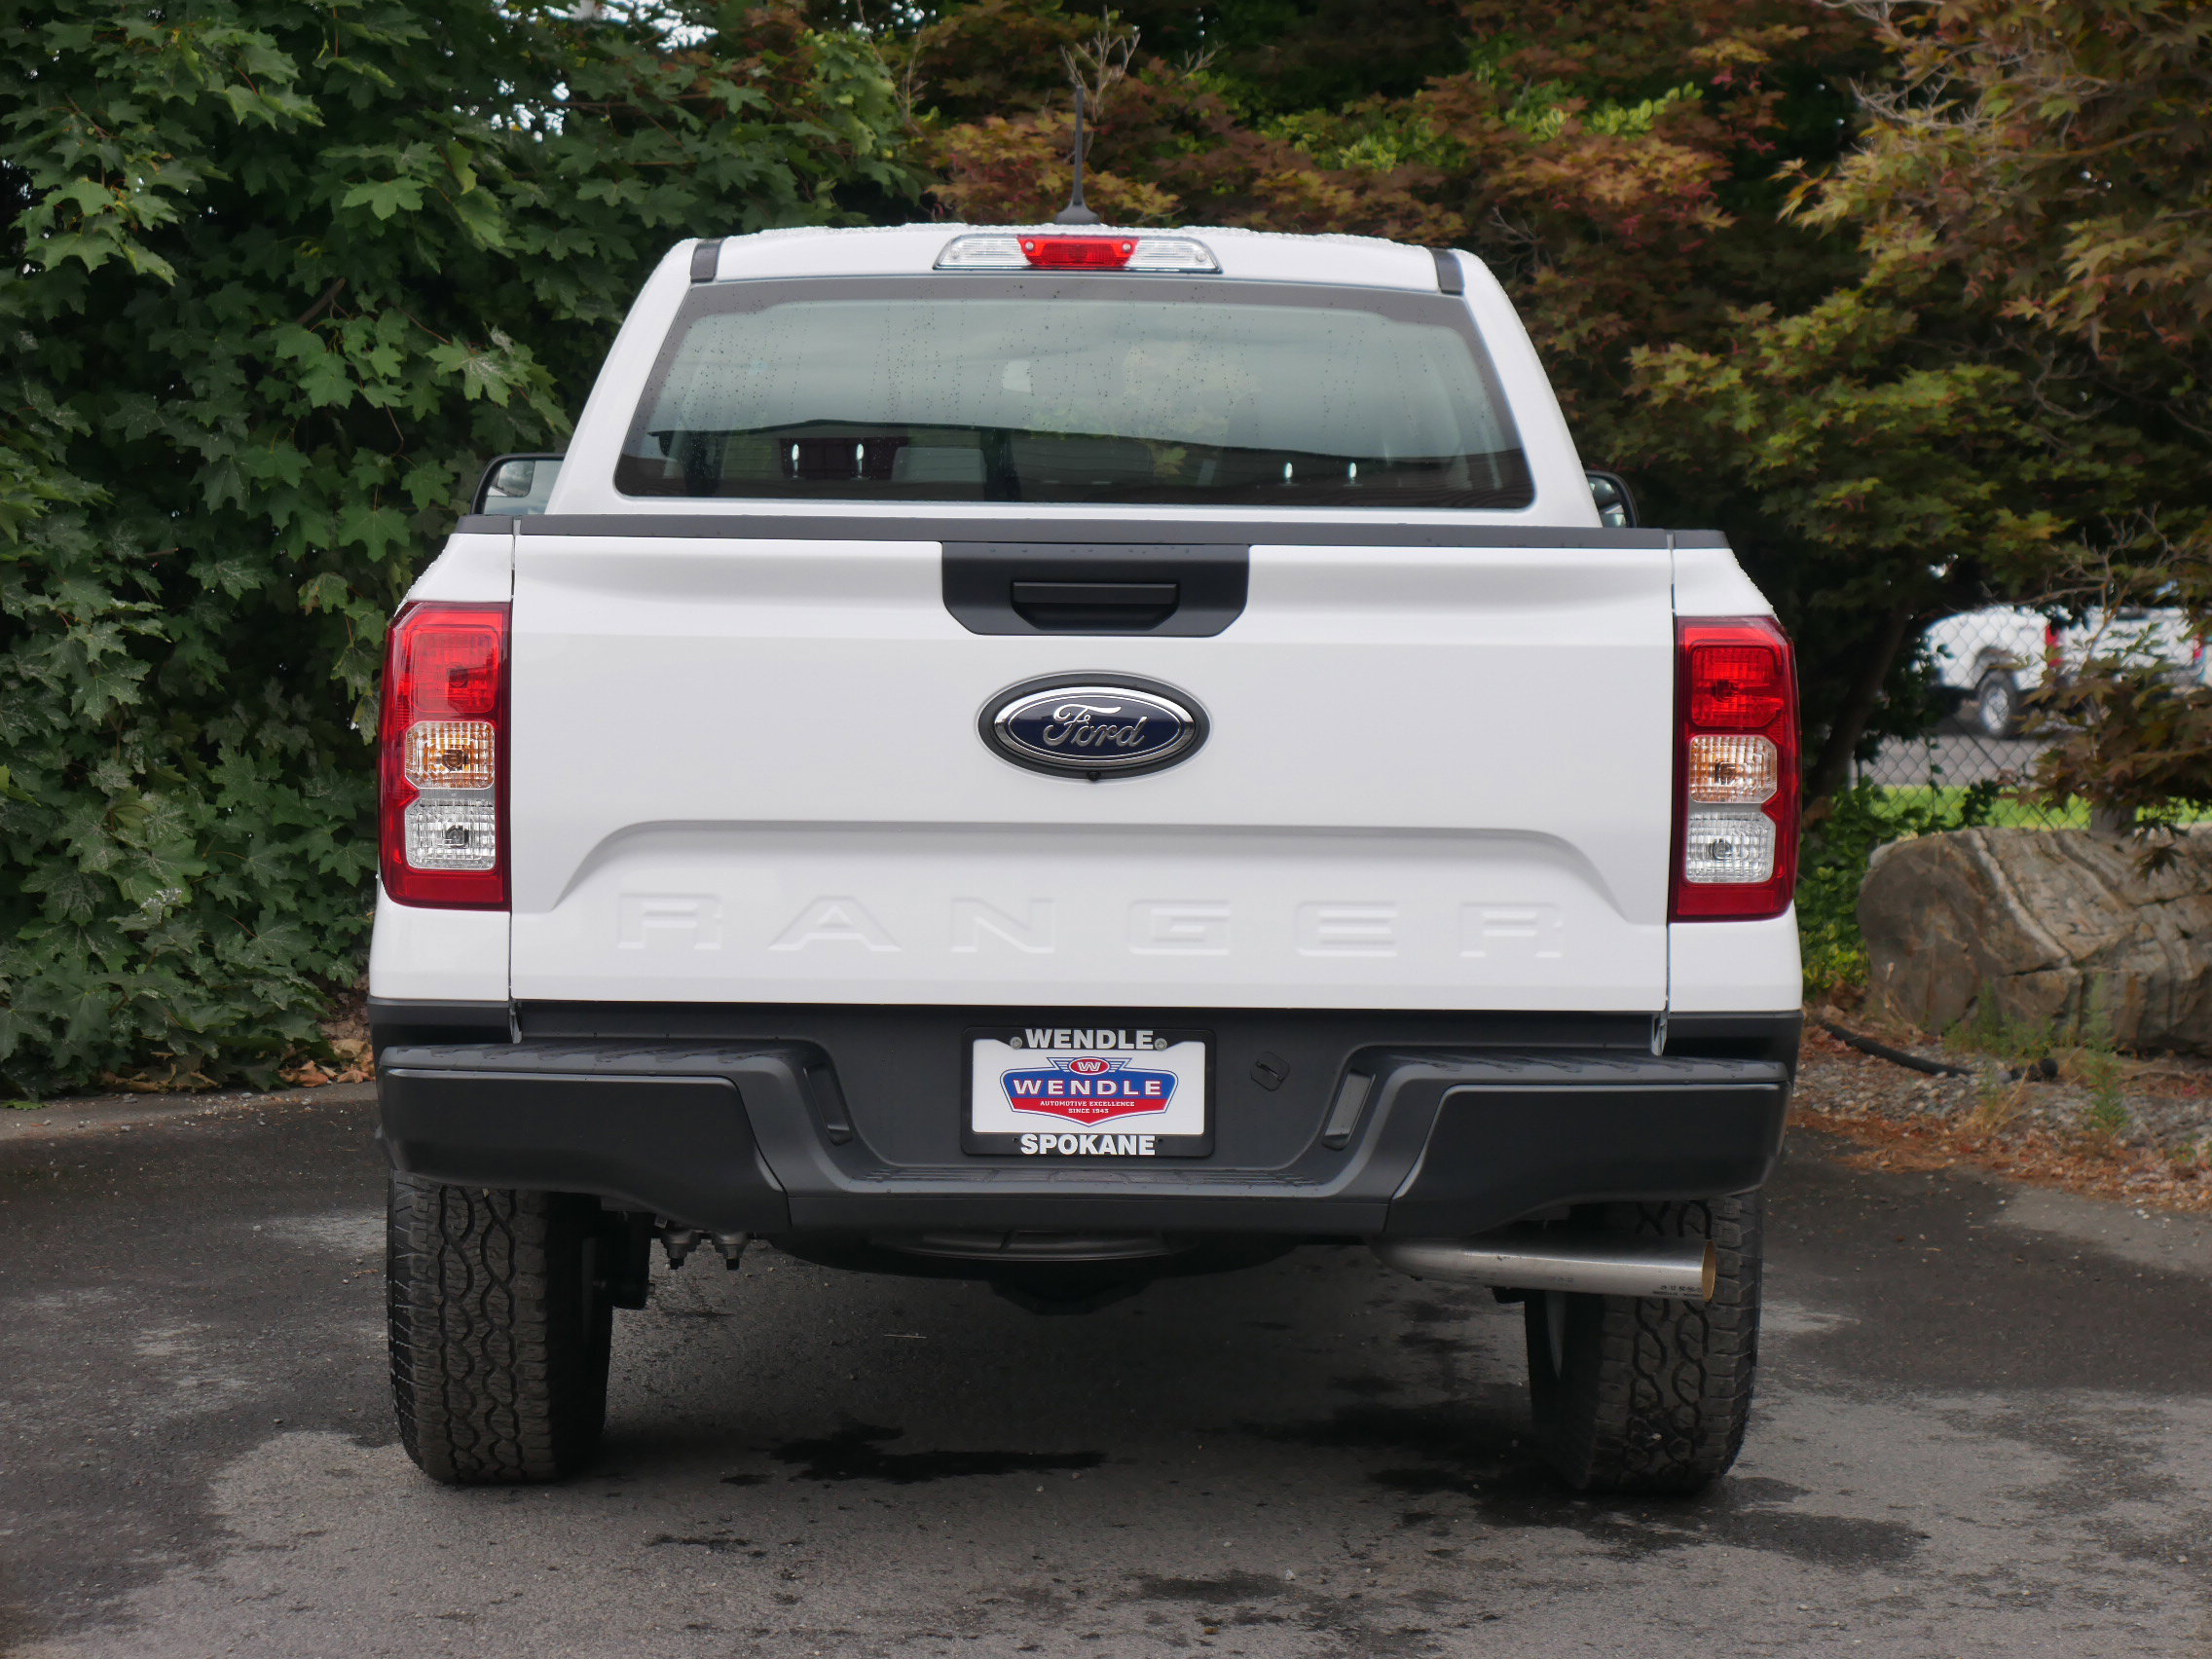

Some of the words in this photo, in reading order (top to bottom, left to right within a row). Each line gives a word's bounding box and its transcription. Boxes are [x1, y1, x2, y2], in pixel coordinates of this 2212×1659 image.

[1043, 703, 1147, 747] Ford
[617, 892, 1564, 959] RANGER
[1025, 1028, 1154, 1050] WENDLE
[1013, 1079, 1161, 1096] WENDLE
[1020, 1133, 1156, 1156] SPOKANE
